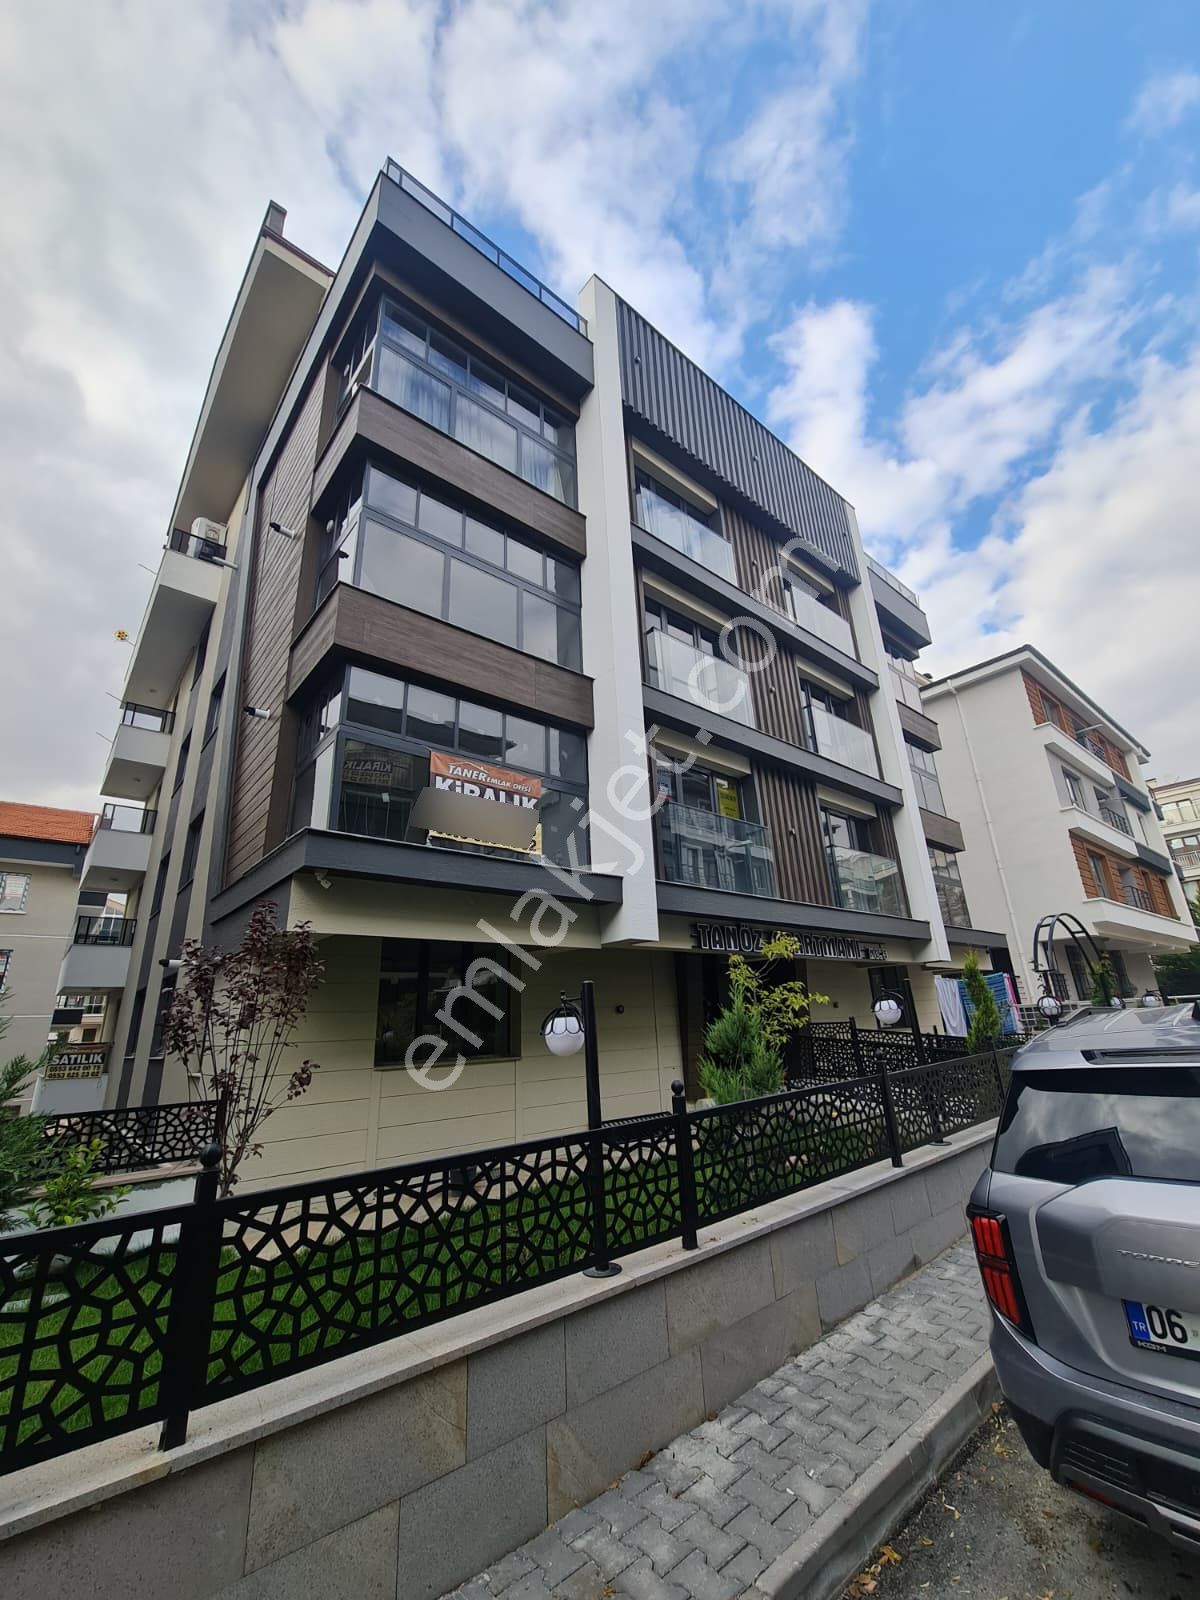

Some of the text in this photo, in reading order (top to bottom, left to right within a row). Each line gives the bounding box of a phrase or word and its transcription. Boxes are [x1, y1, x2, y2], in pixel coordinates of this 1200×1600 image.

[448, 764, 489, 783] TANER
[487, 776, 512, 788] EMLAK
[51, 1053, 103, 1065] SATILIK
[1131, 1305, 1188, 1344] TR 06
